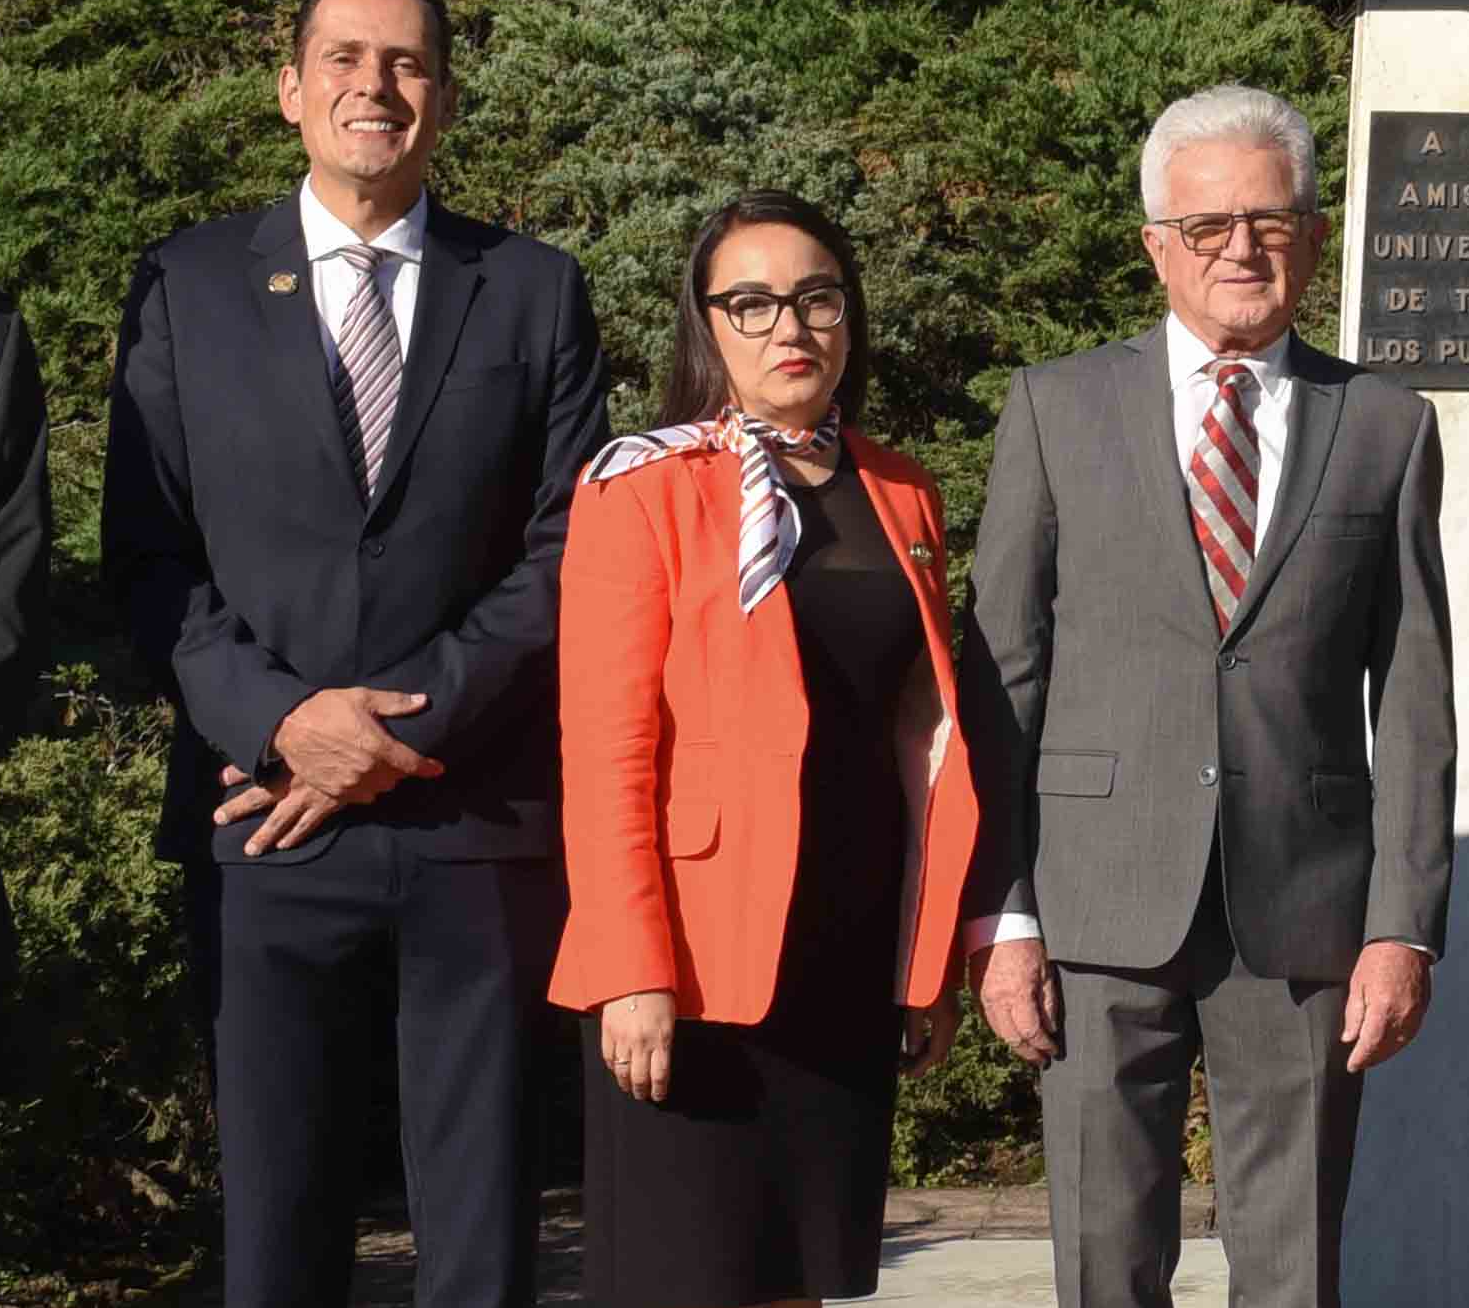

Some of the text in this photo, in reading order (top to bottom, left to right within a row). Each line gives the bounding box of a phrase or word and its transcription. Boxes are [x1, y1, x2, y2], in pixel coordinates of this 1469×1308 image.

[1420, 131, 1444, 155] A
[1388, 288, 1428, 313] DE
[1366, 338, 1422, 364] LOS
